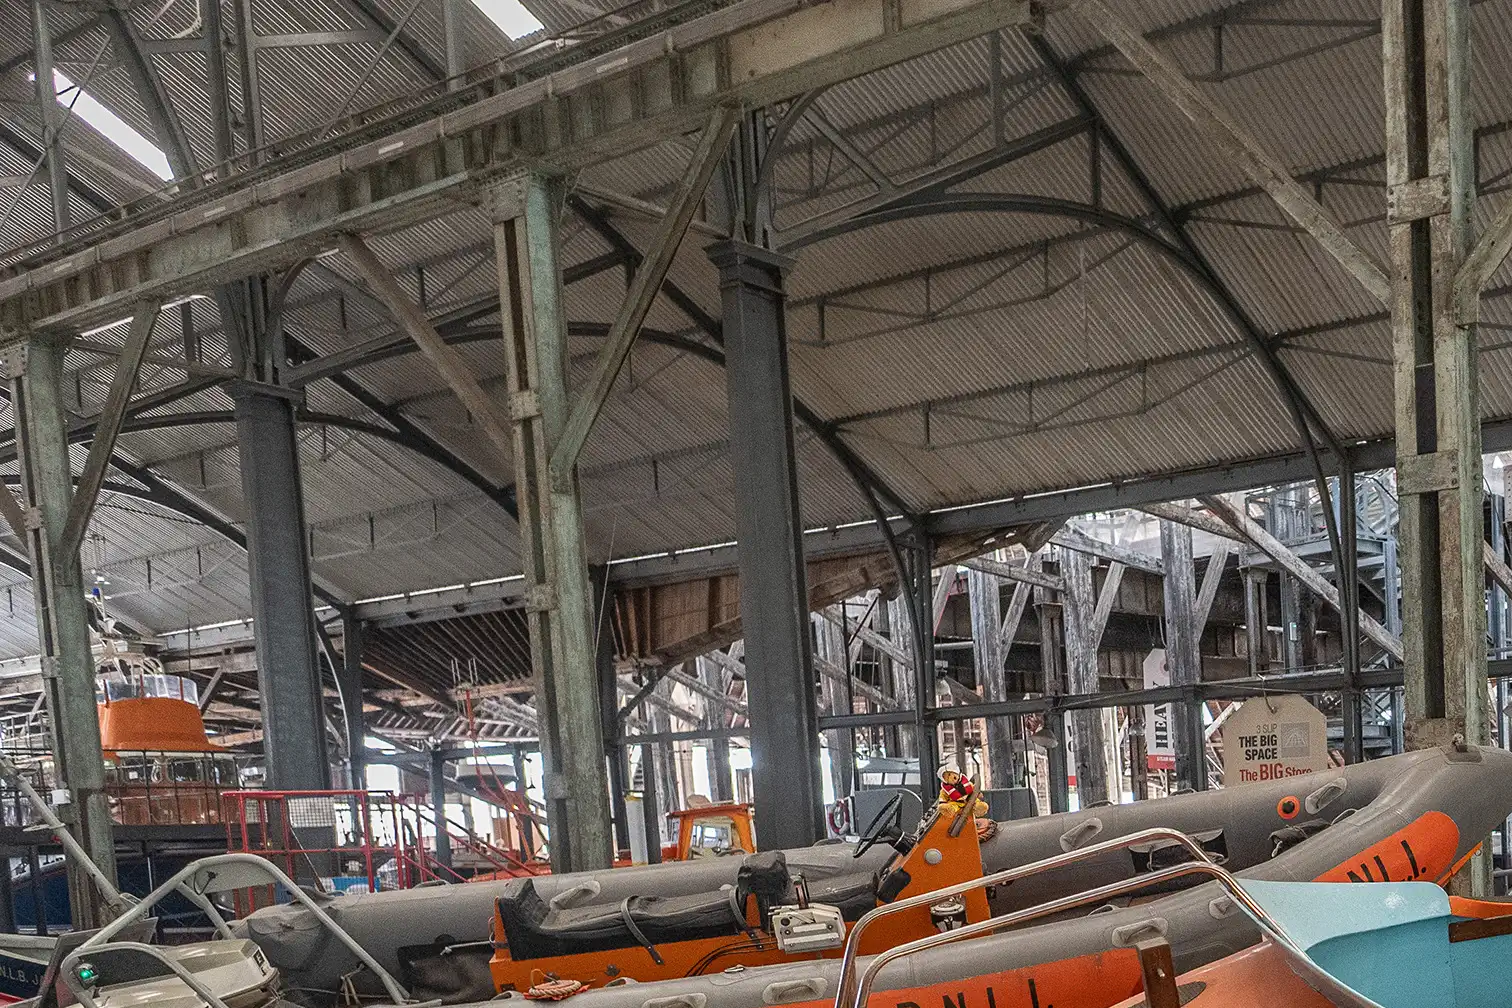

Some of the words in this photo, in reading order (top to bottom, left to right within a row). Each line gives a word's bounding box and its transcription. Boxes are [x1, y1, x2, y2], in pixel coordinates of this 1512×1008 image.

[1239, 736, 1258, 748] THE
[1260, 734, 1278, 747] BIG
[1245, 748, 1278, 760] SPACE
[1240, 769, 1258, 781] The
[1260, 763, 1283, 780] BIG
